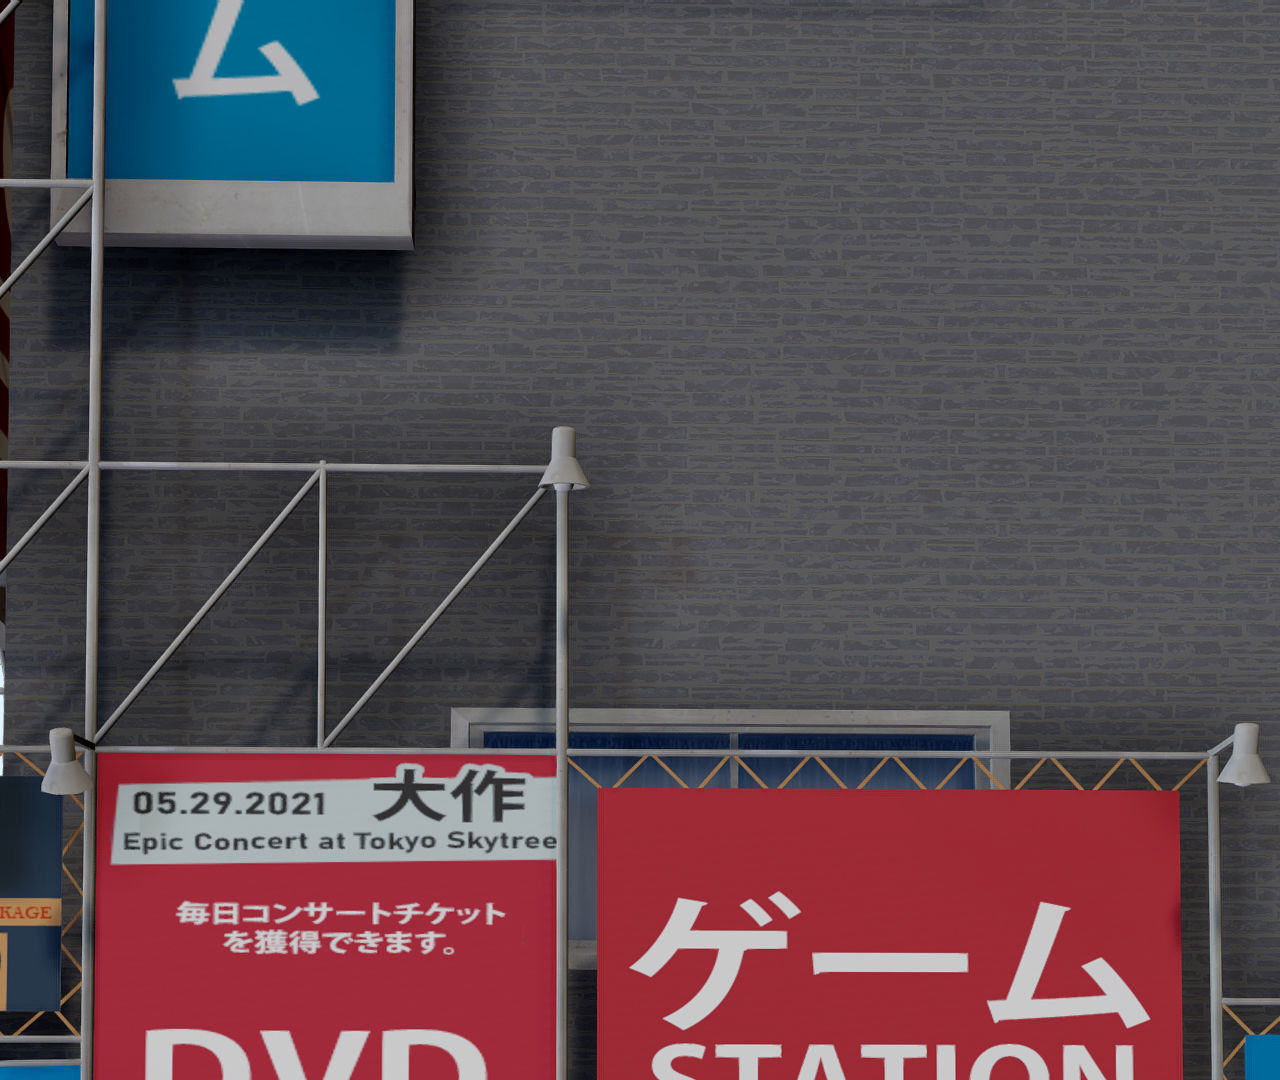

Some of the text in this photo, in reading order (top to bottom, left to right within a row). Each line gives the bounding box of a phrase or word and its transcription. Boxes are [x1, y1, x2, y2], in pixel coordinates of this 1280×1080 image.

[173, 0, 320, 106] ム
[134, 791, 324, 815] 05.29.2021
[373, 769, 526, 822] 大作
[124, 831, 557, 855] Epic Concert at Tokyo Skytree
[176, 901, 505, 925] 毎日コンサートチケット
[223, 929, 454, 955] を獲得できます。
[629, 891, 1150, 1030] ゲーム
